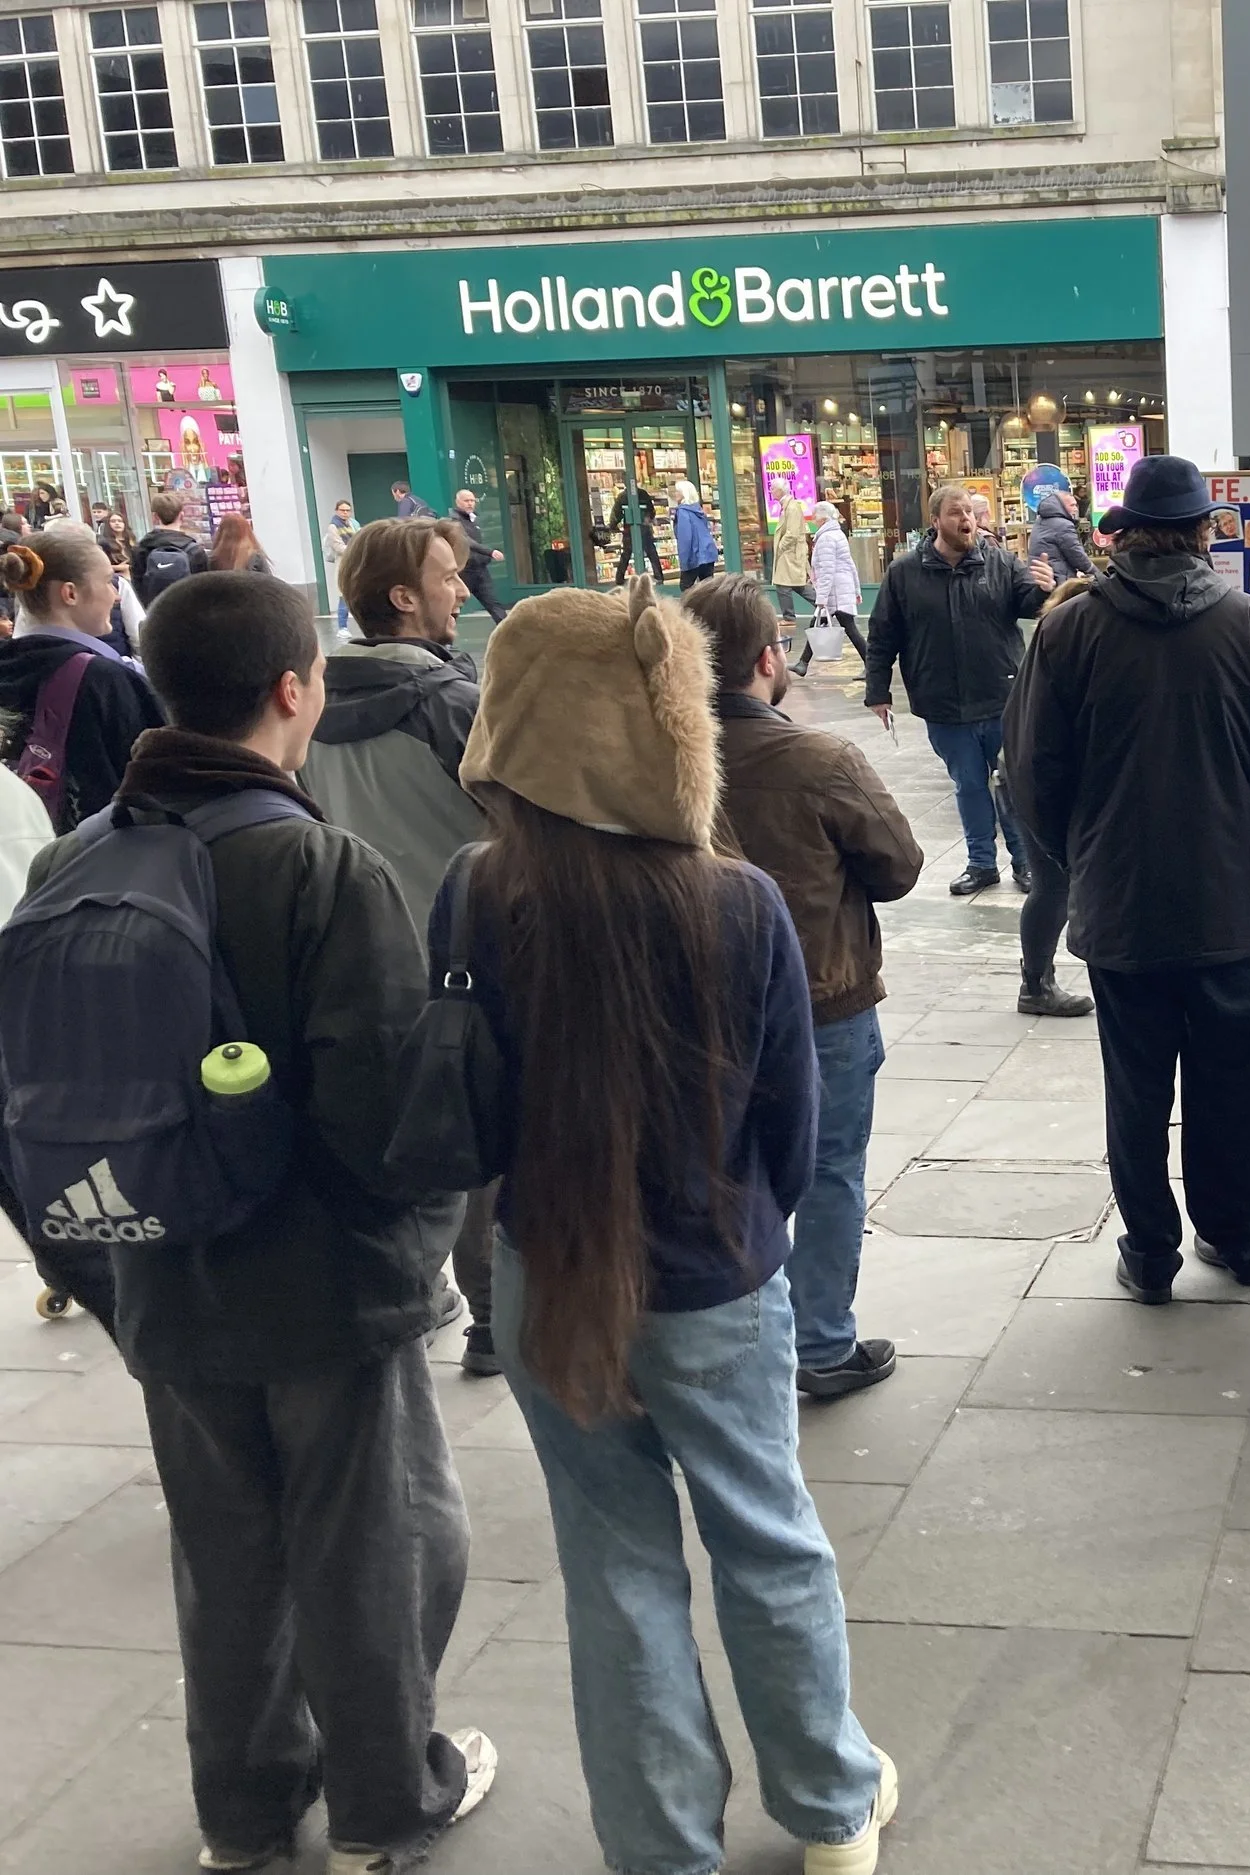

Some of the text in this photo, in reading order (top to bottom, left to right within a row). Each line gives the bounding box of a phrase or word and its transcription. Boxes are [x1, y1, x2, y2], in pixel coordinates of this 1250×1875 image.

[458, 270, 685, 334] Holland
[734, 262, 949, 323] Barrett
[218, 432, 235, 446] PAY
[1095, 452, 1110, 461] ADD
[766, 460, 779, 471] ADD
[1095, 462, 1124, 471] TO YOUR
[1095, 472, 1121, 482] BILL AT
[1096, 481, 1124, 491] THE TILL
[41, 1215, 166, 1243] adidas
